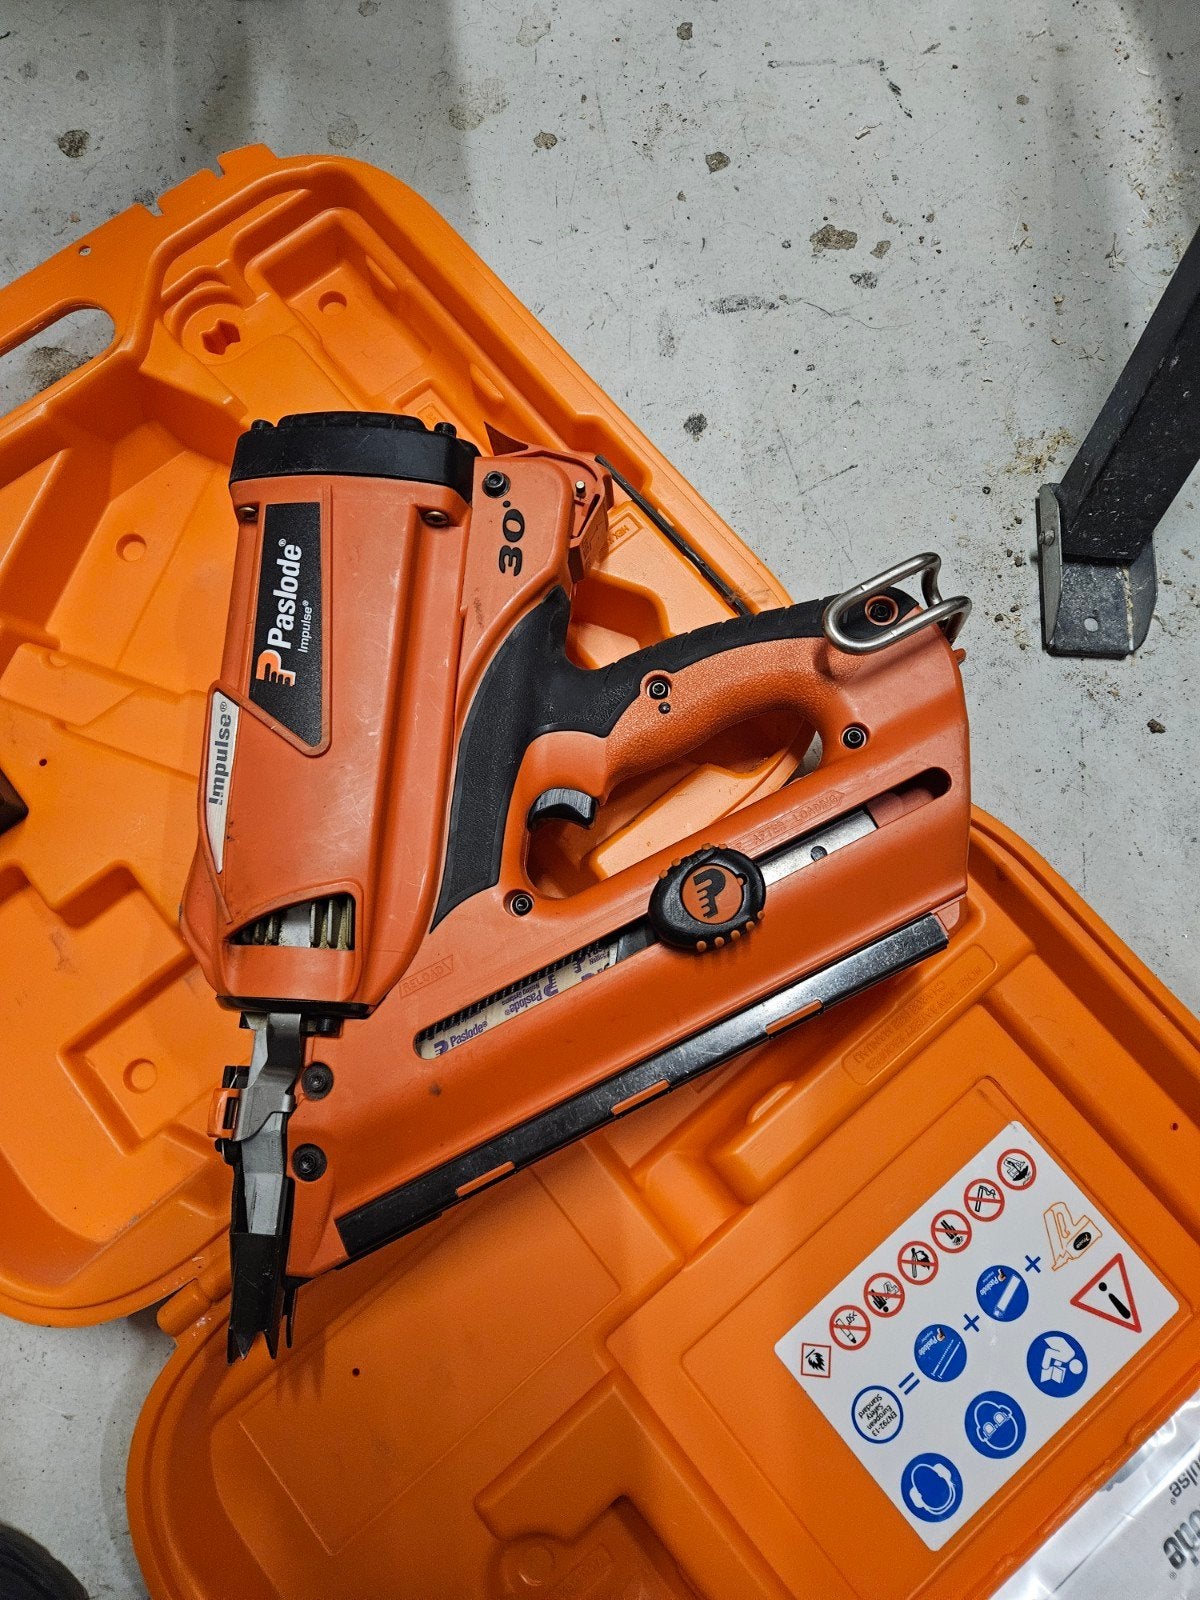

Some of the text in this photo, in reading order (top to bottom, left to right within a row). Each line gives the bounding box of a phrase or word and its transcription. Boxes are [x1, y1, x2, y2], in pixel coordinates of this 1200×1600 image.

[793, 794, 839, 824] LOADING
[402, 965, 444, 993] RELOAD
[858, 1393, 883, 1419] Standard
[866, 1403, 884, 1420] Safety
[866, 1405, 893, 1430] European
